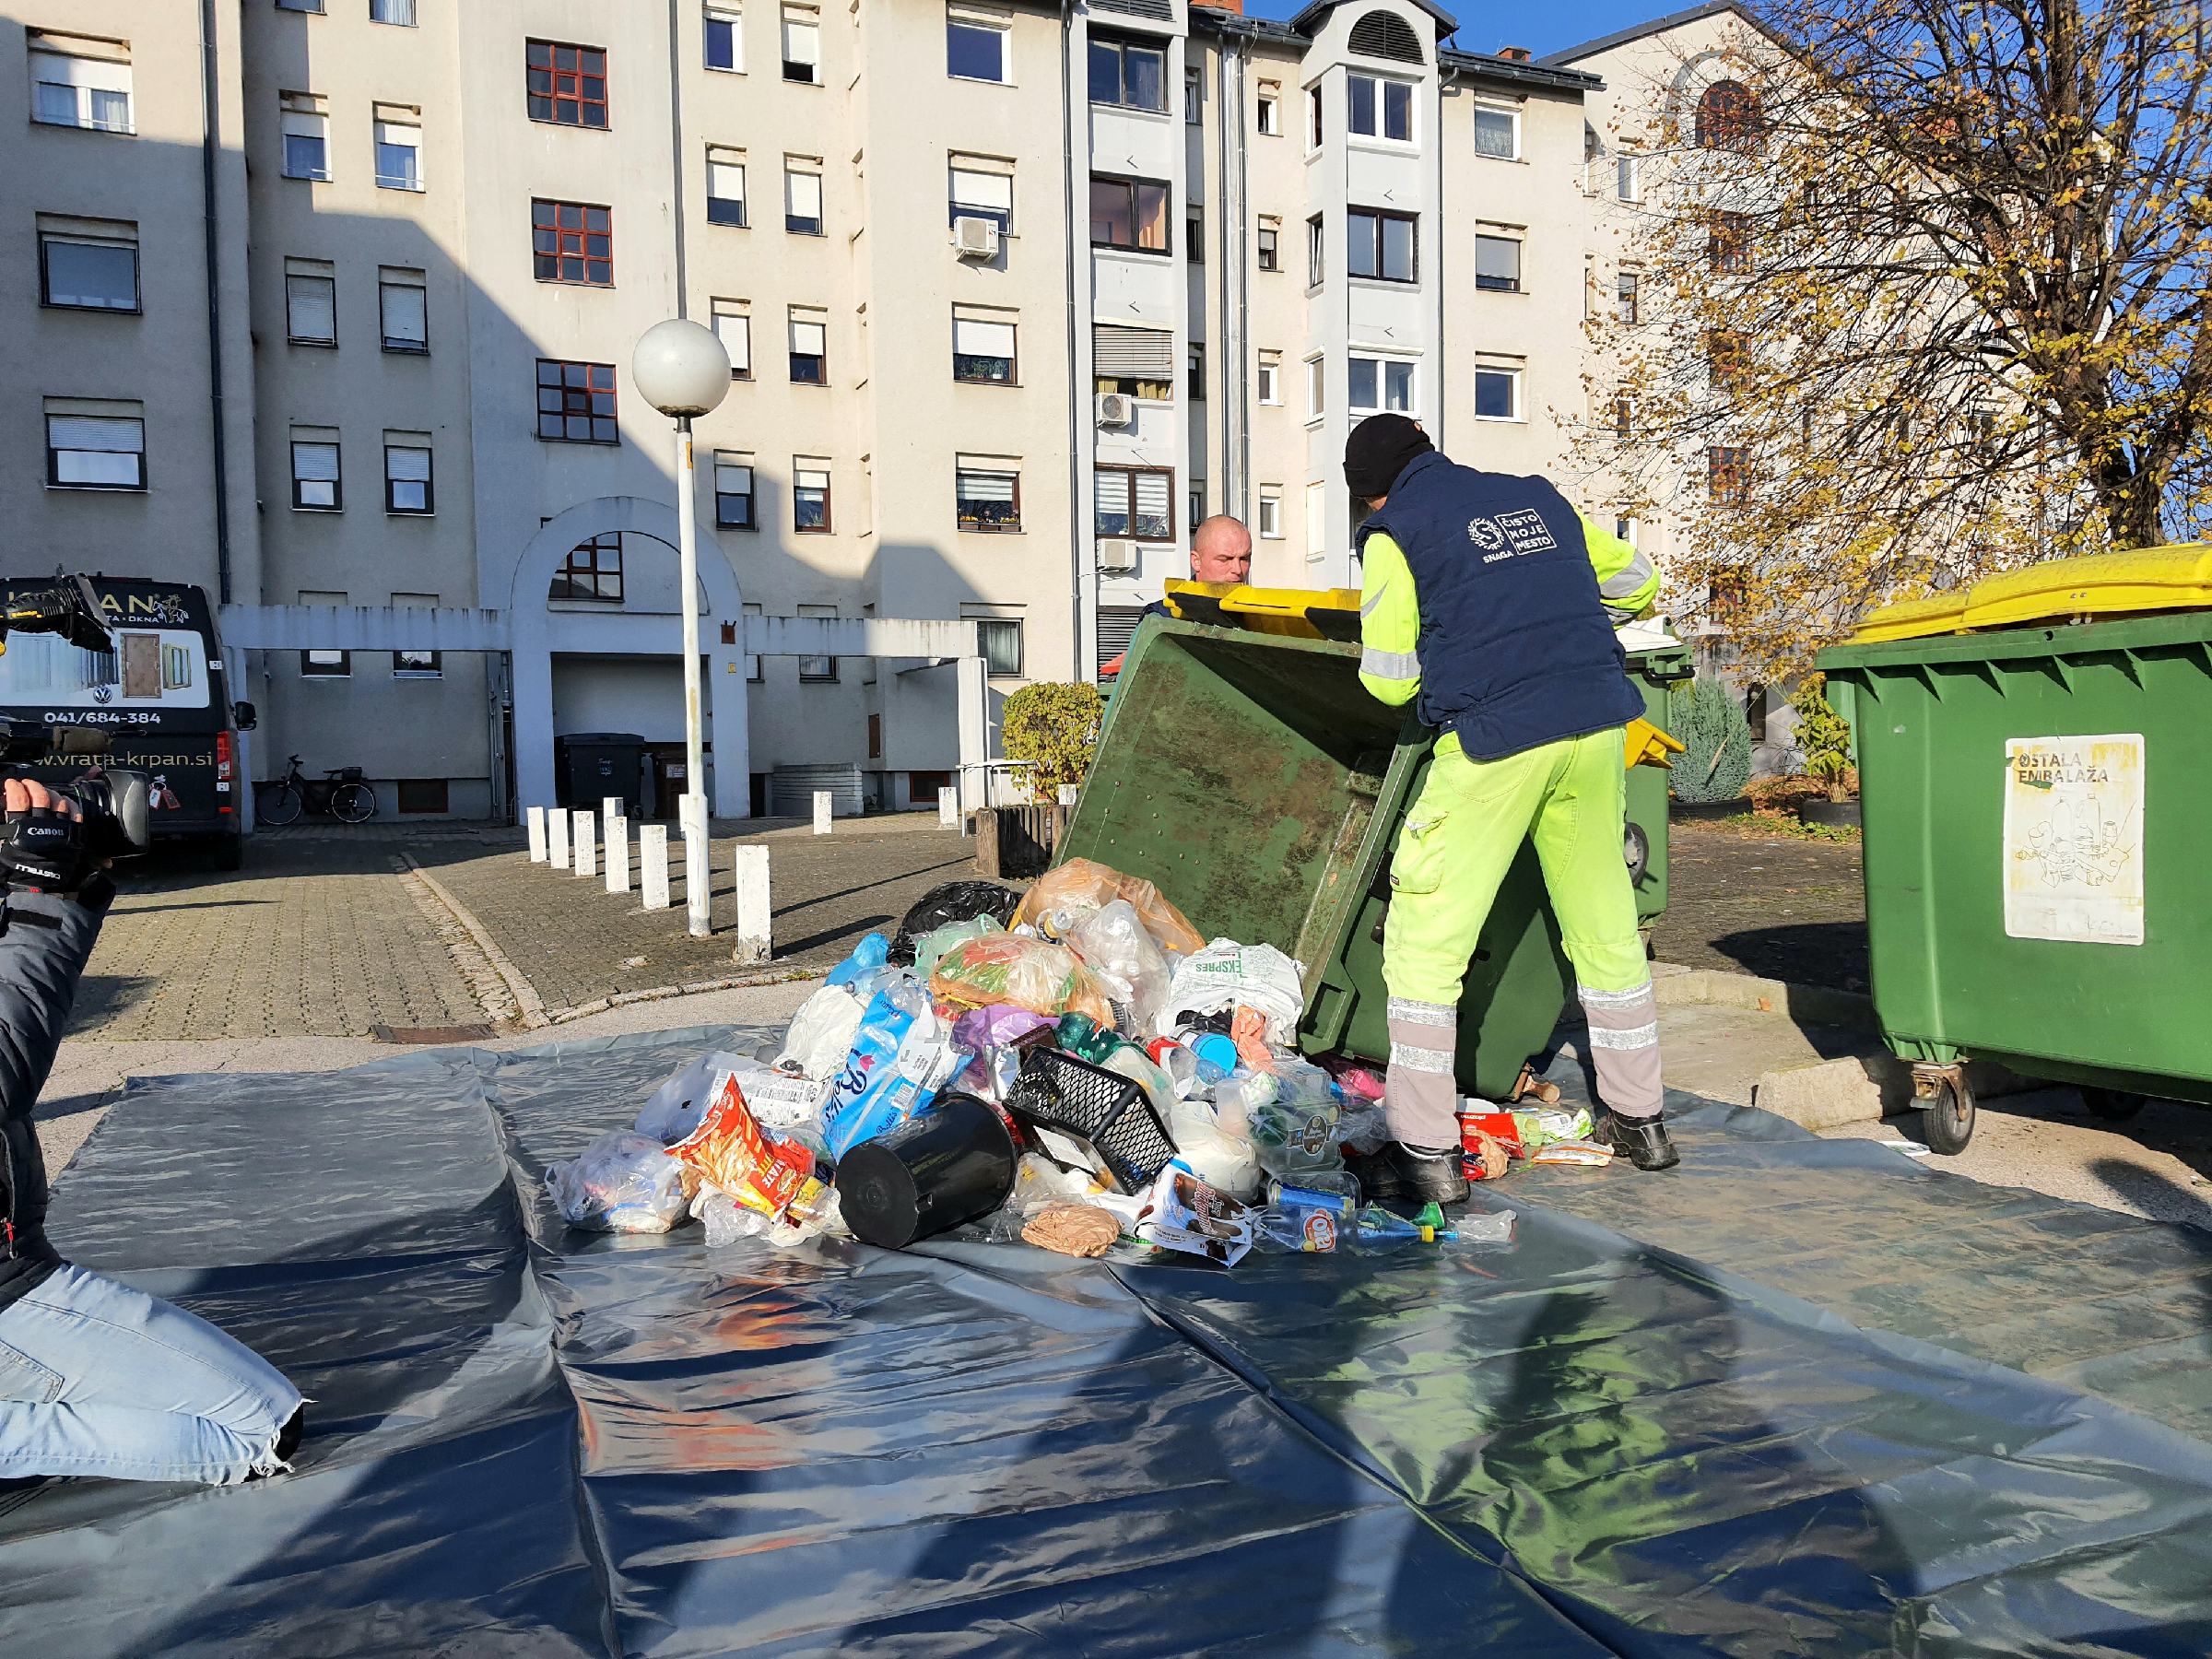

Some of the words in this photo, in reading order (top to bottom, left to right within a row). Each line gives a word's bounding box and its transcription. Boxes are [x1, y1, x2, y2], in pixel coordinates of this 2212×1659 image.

[1500, 514, 1537, 527] ČISTO
[1509, 524, 1545, 540] MOJE
[1515, 536, 1551, 551] MESTO
[1483, 550, 1514, 564] SNAGA
[44, 712, 161, 724] 041/684-384
[38, 751, 212, 768] w.vrata-krpan.si
[2018, 752, 2082, 768] OSTALA
[2018, 765, 2109, 782] EMBALAŽA
[27, 827, 65, 836] Canon
[1195, 959, 1241, 973] EKSPRES
